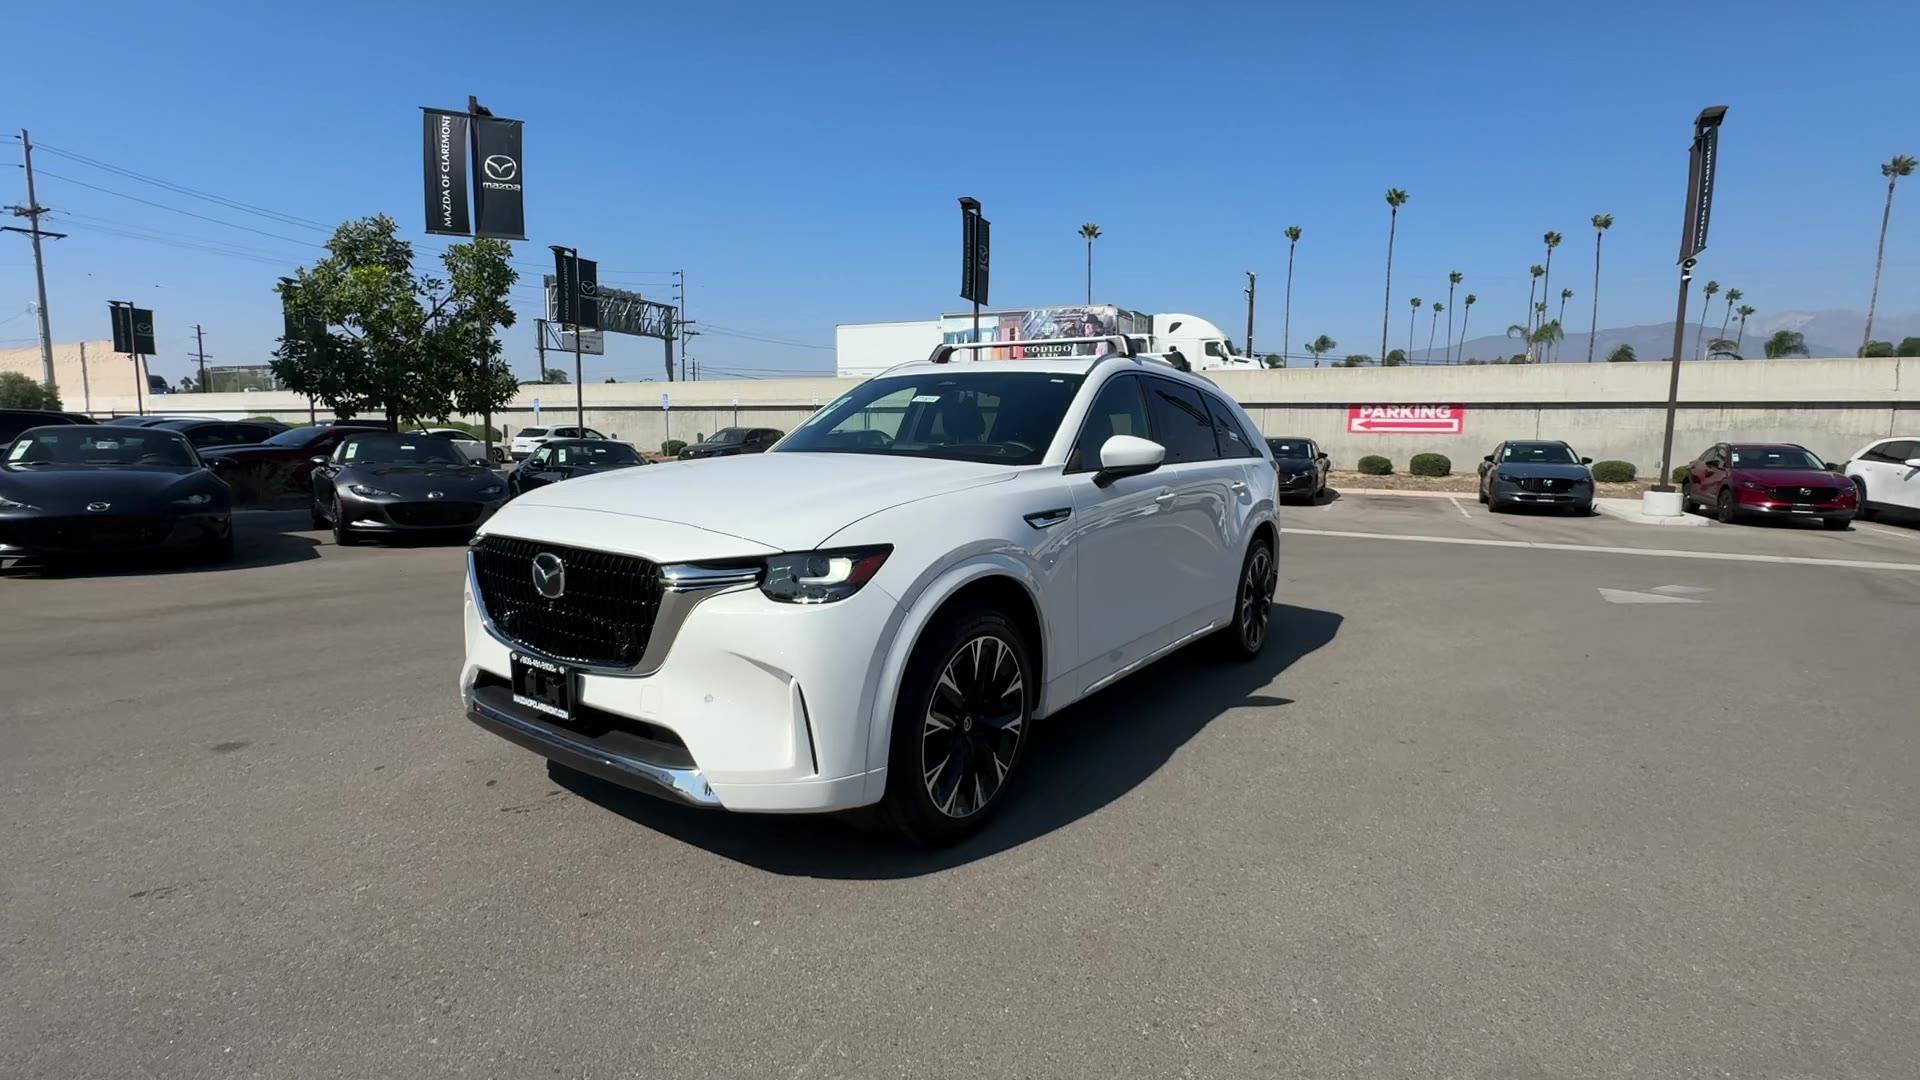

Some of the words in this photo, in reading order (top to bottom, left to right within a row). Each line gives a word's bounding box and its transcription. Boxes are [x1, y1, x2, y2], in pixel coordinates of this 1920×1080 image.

[441, 115, 451, 172] CLAREMONT
[441, 174, 450, 188] OF
[442, 189, 452, 227] MAZDA
[1360, 404, 1451, 419] PARKING
